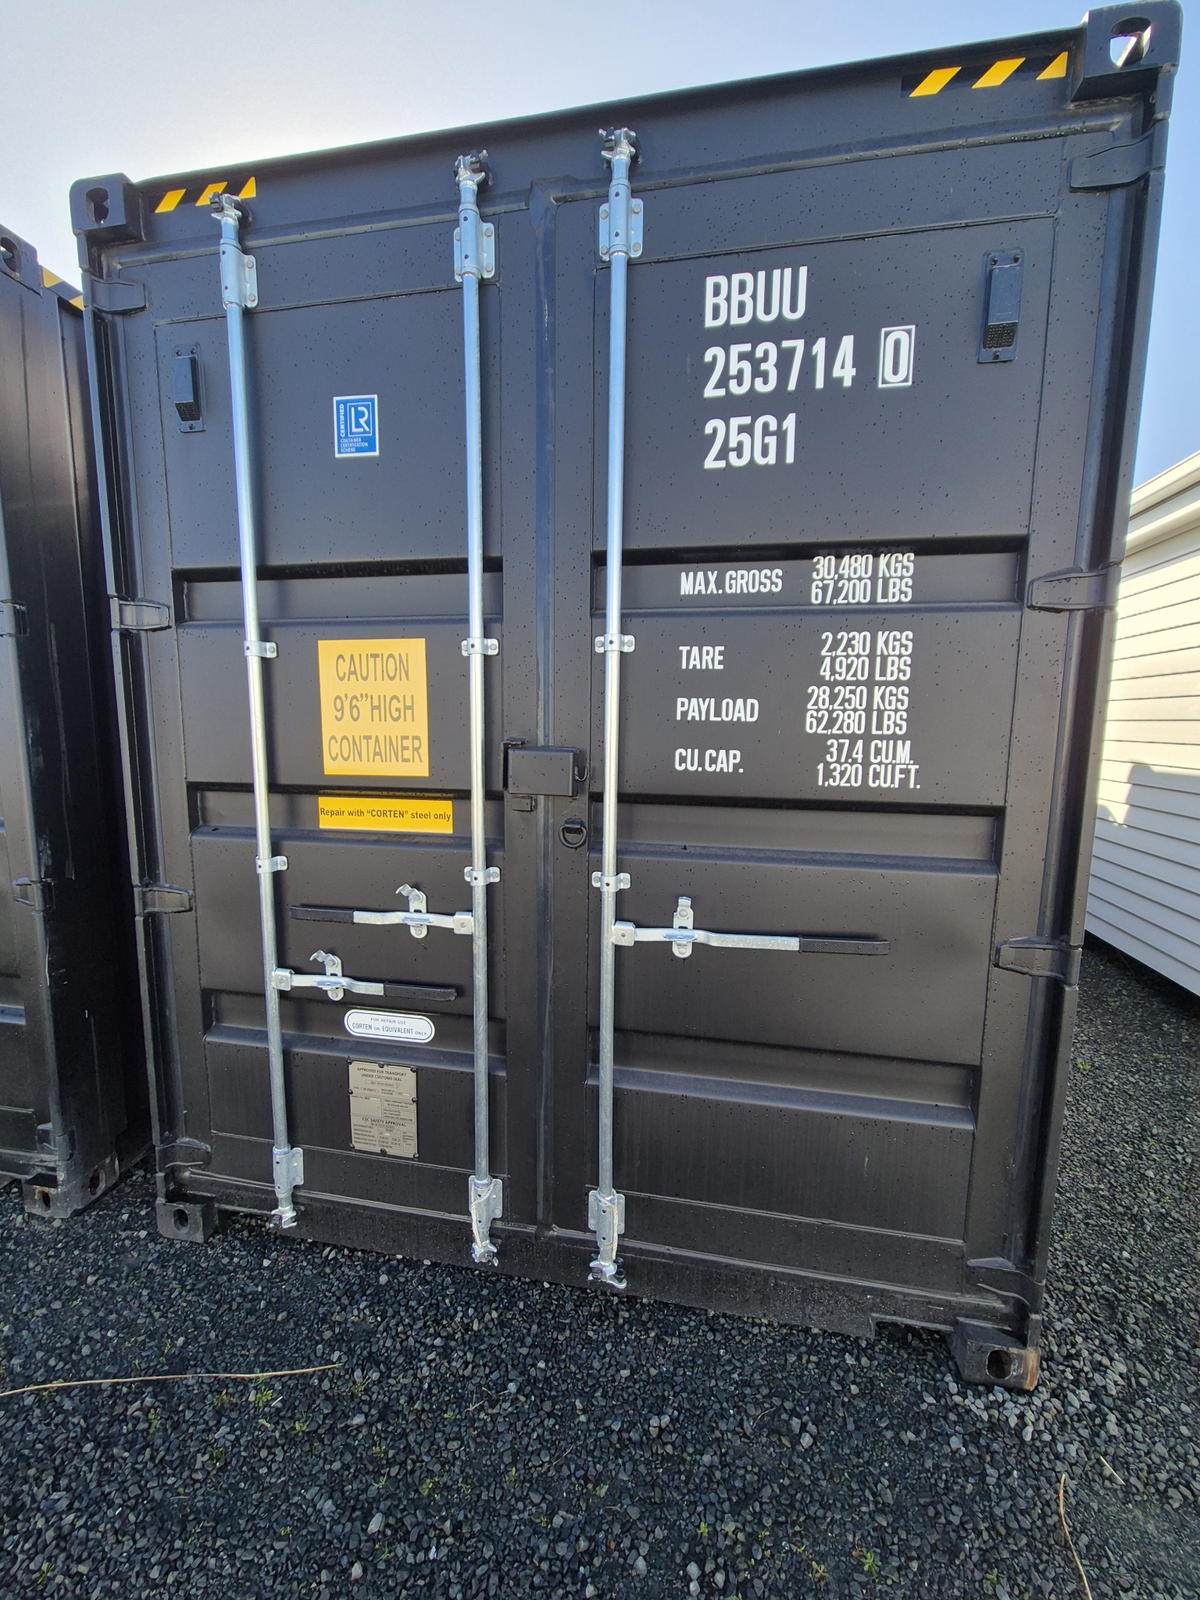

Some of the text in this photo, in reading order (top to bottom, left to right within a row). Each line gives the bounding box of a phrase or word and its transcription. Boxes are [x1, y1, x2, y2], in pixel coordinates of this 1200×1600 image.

[705, 266, 808, 327] BBUU
[704, 330, 909, 398] 253714 0
[351, 407, 369, 432] LR
[704, 413, 796, 469] 25G1
[812, 554, 873, 580] 30,480
[878, 553, 914, 578] KGS
[811, 578, 913, 604] 67,200 LBS
[679, 631, 913, 670] TARE 2,230 KGS
[335, 653, 410, 682] CAUTION
[820, 657, 911, 681] 4,920 LBS
[676, 686, 909, 722] PAYLOAD 28,250 KGS
[806, 711, 907, 735] 62,280 LBS
[328, 734, 423, 763] CONTAINER
[826, 740, 863, 763] 37.4
[870, 740, 913, 764] CU.M.
[817, 763, 920, 789] 1,320 CU.FT.
[320, 808, 345, 817] Repair
[348, 808, 364, 817] with
[411, 811, 431, 820] steel
[434, 812, 451, 822] only
[382, 1026, 413, 1035] EQUIVALENT
